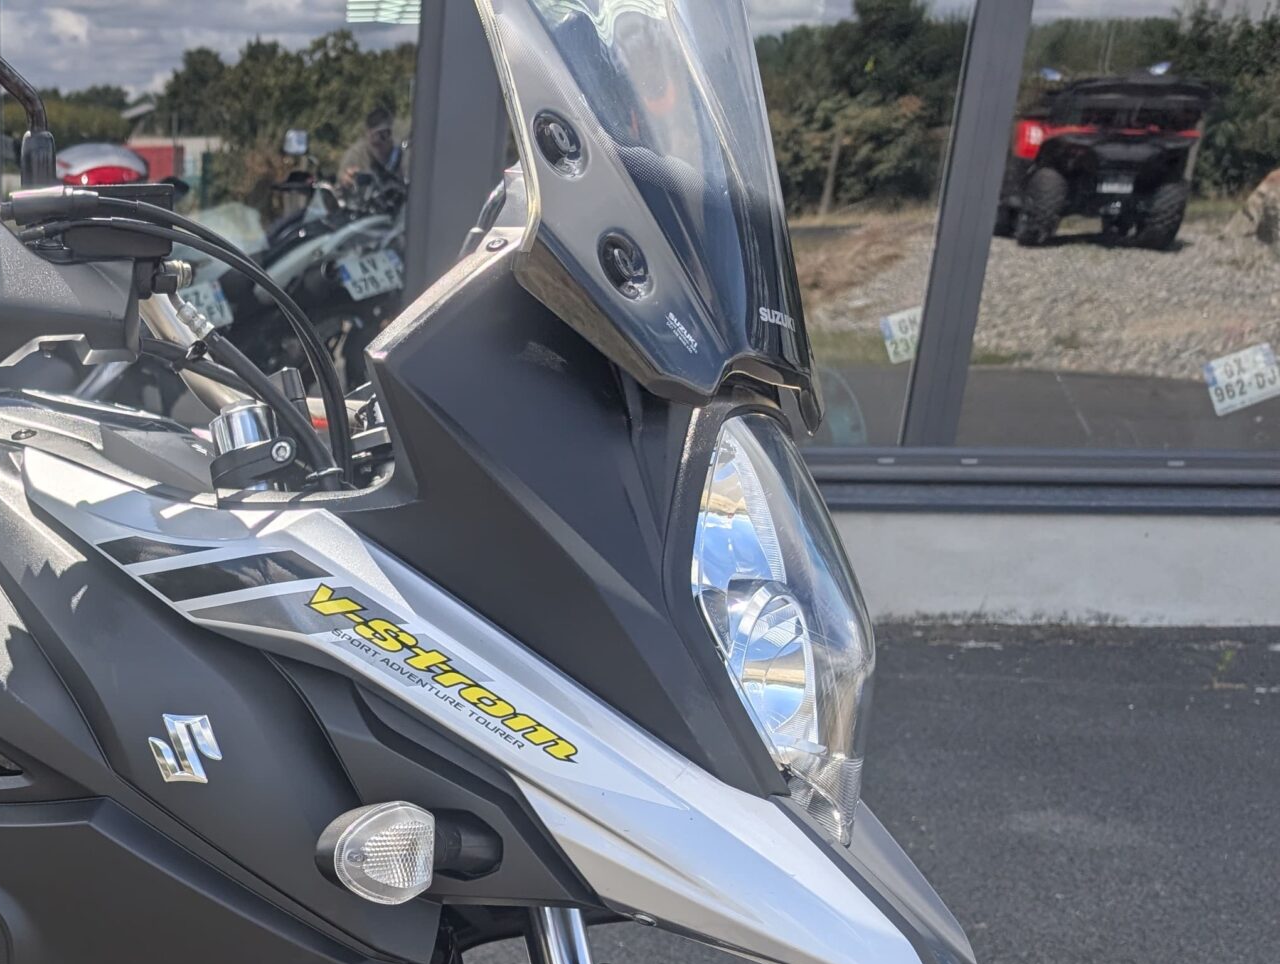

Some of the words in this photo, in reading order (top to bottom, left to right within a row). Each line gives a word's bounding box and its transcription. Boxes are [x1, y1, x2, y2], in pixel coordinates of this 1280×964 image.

[667, 311, 699, 349] SUZUKI
[758, 306, 796, 333] SUZUKI
[331, 627, 381, 660] SPORT
[381, 656, 466, 712] ADVENTURE
[468, 709, 526, 751] TOURER
